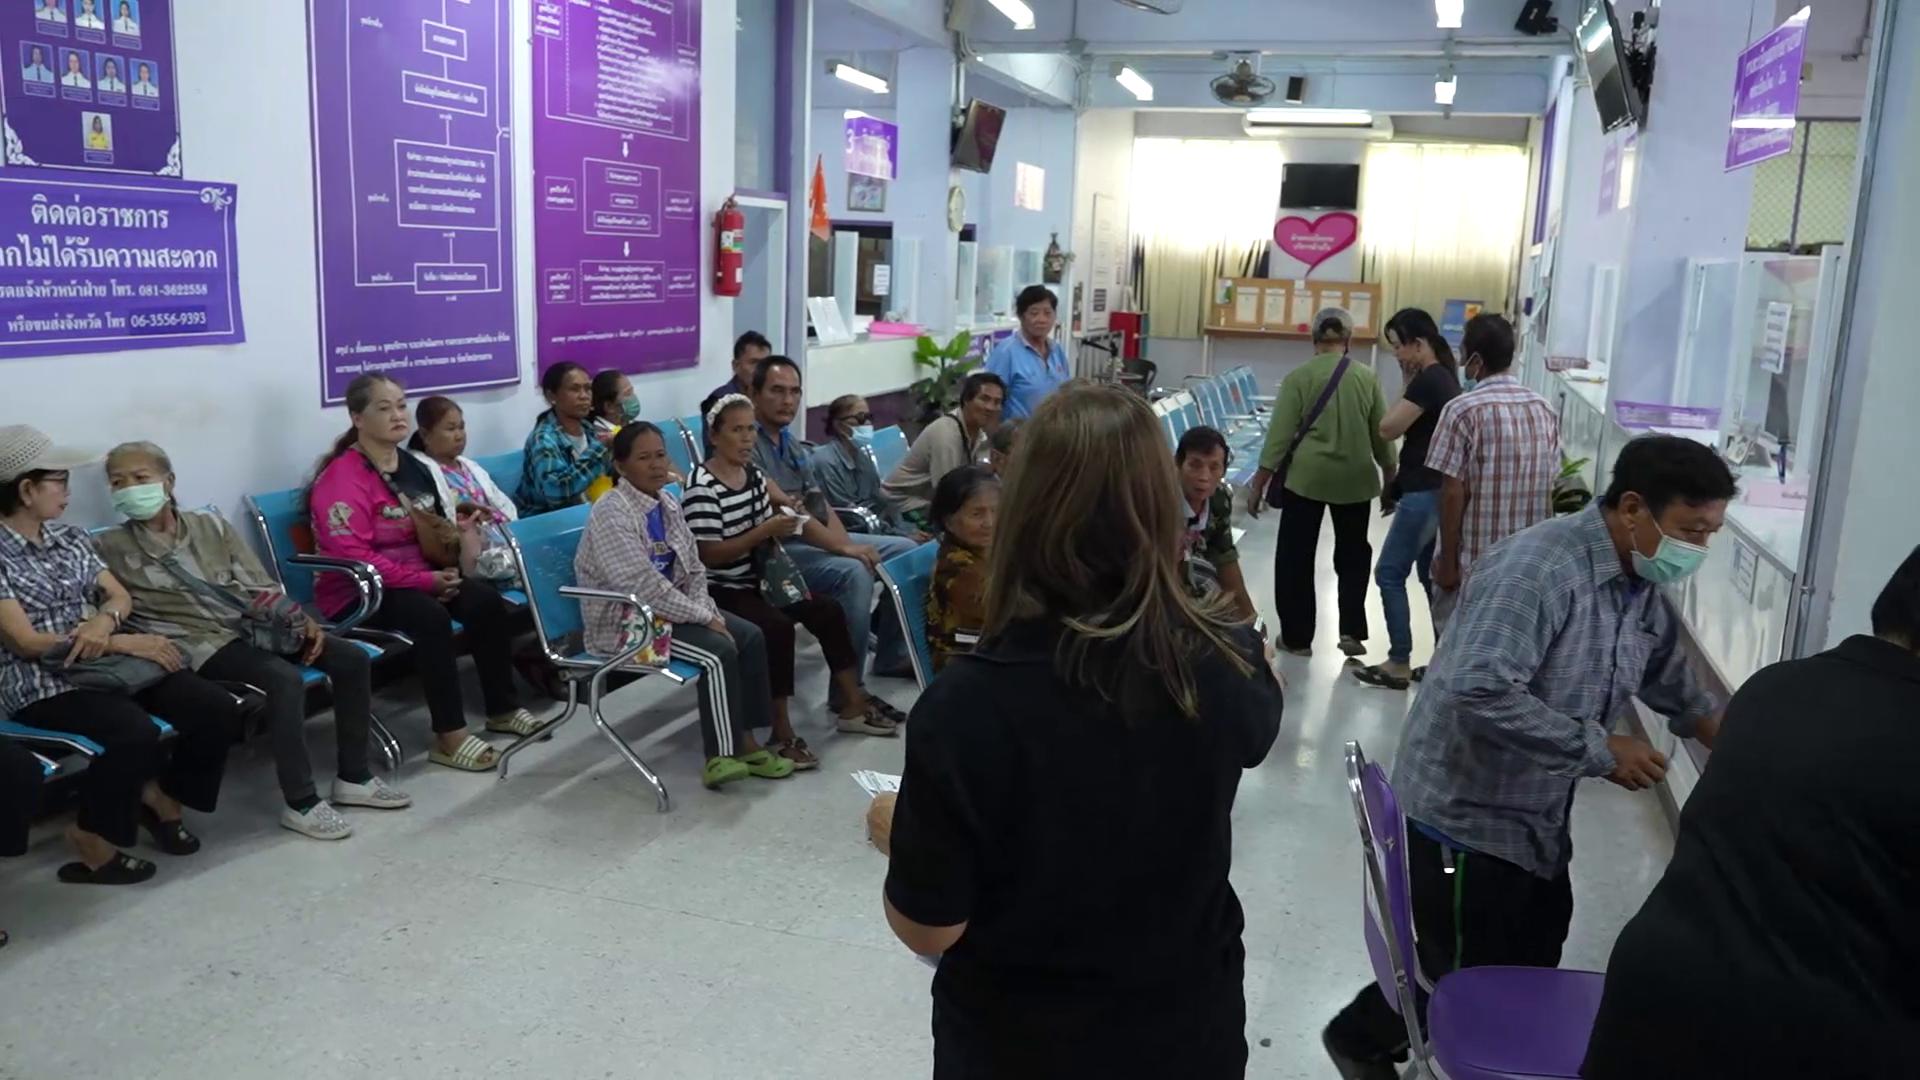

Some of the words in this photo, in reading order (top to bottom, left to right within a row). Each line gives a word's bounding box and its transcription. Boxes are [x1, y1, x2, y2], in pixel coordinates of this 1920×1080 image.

[32, 193, 169, 229] ติดต่อราชการ
[131, 311, 207, 329] 06-3556-9393
